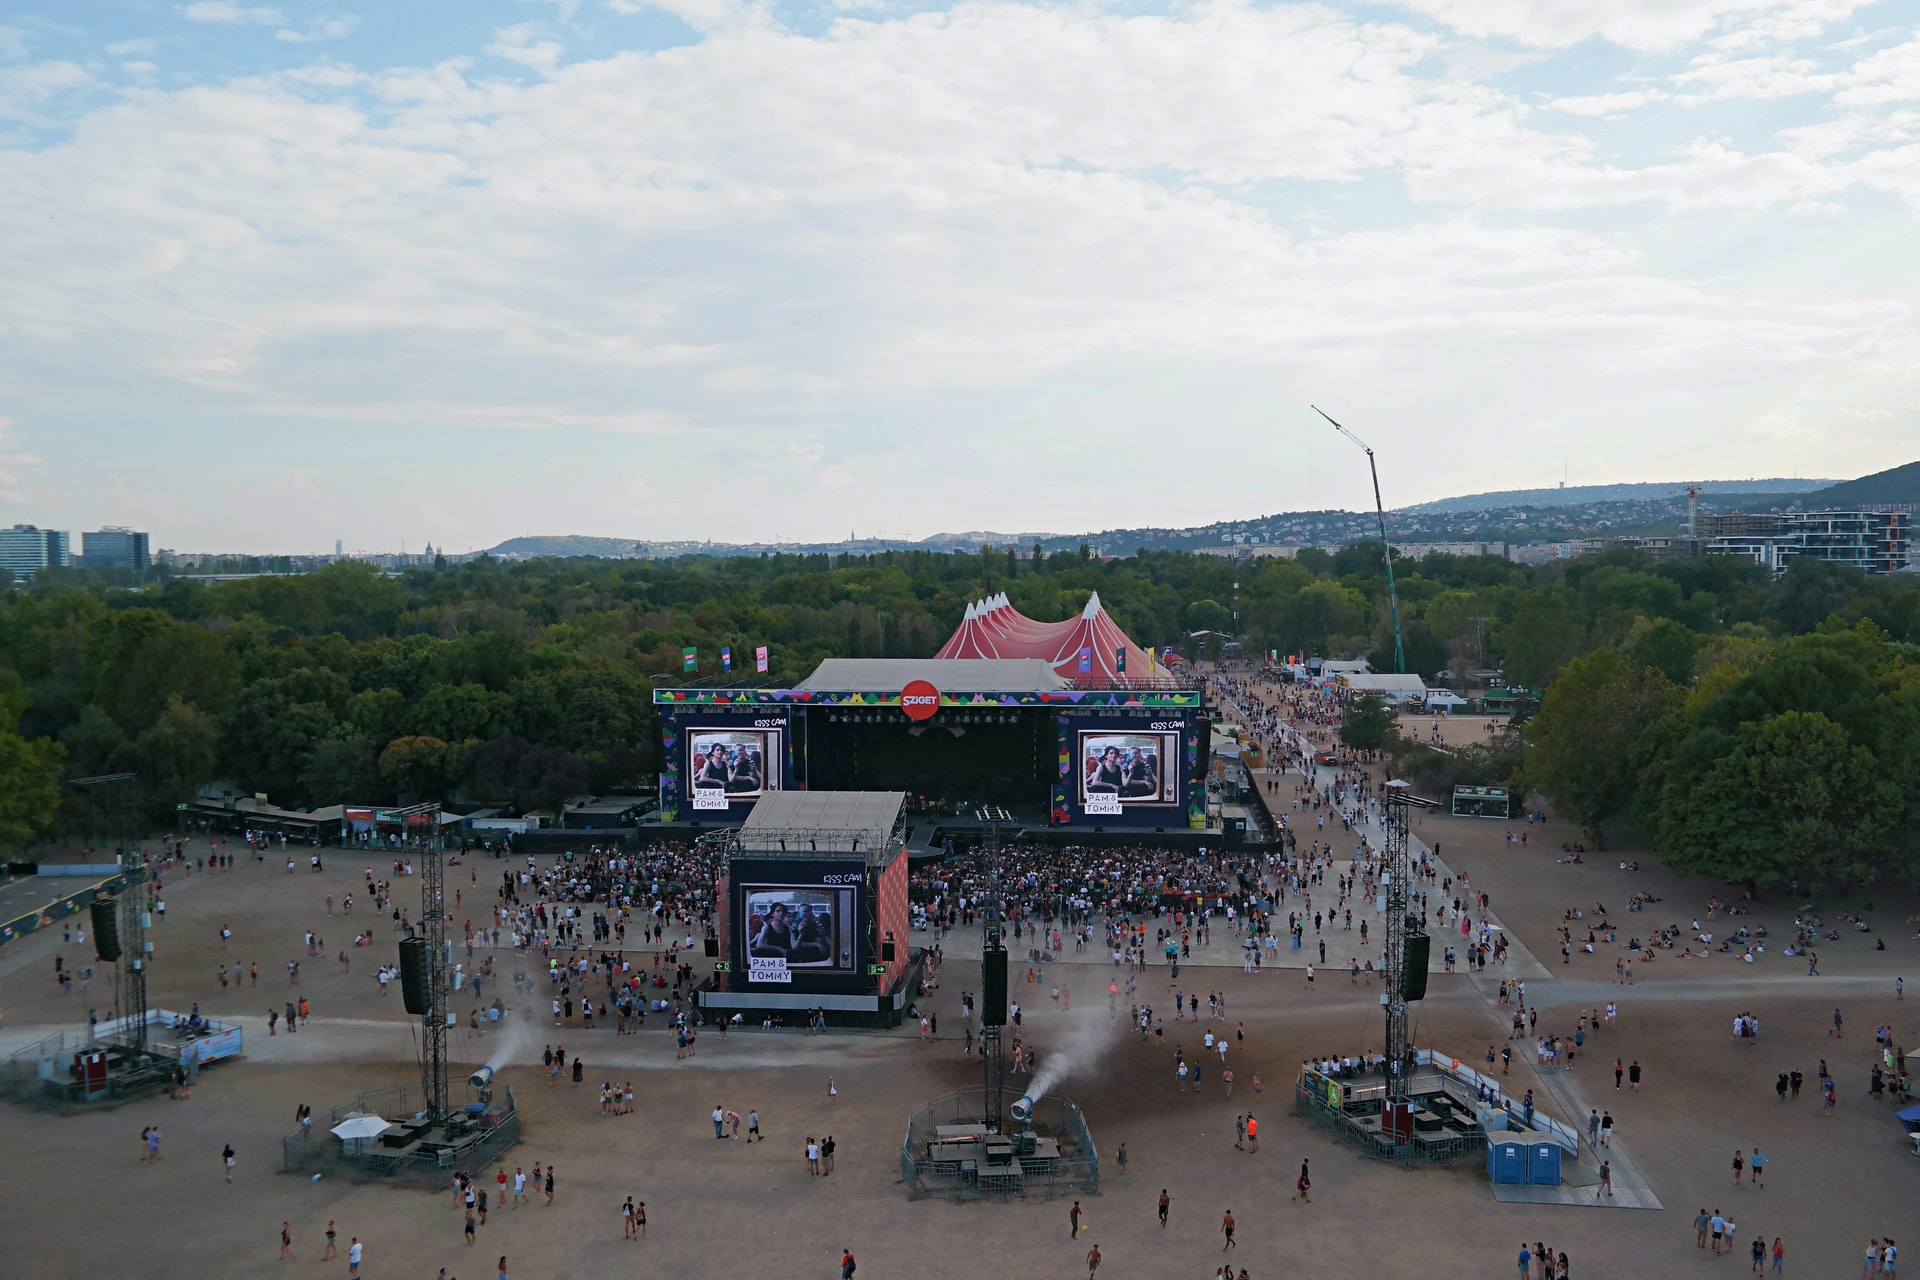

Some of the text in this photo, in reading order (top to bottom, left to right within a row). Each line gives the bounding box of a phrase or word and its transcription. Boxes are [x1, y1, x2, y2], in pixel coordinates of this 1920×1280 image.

[754, 718, 786, 727] KISS CAM
[1150, 720, 1185, 730] KISS CAM
[1089, 794, 1109, 802] PAM
[695, 800, 727, 808] TOMMY
[1087, 804, 1121, 812] TOMMY
[823, 873, 862, 884] KISS CAM
[752, 959, 776, 968] PAM
[750, 970, 790, 980] TOMMY
